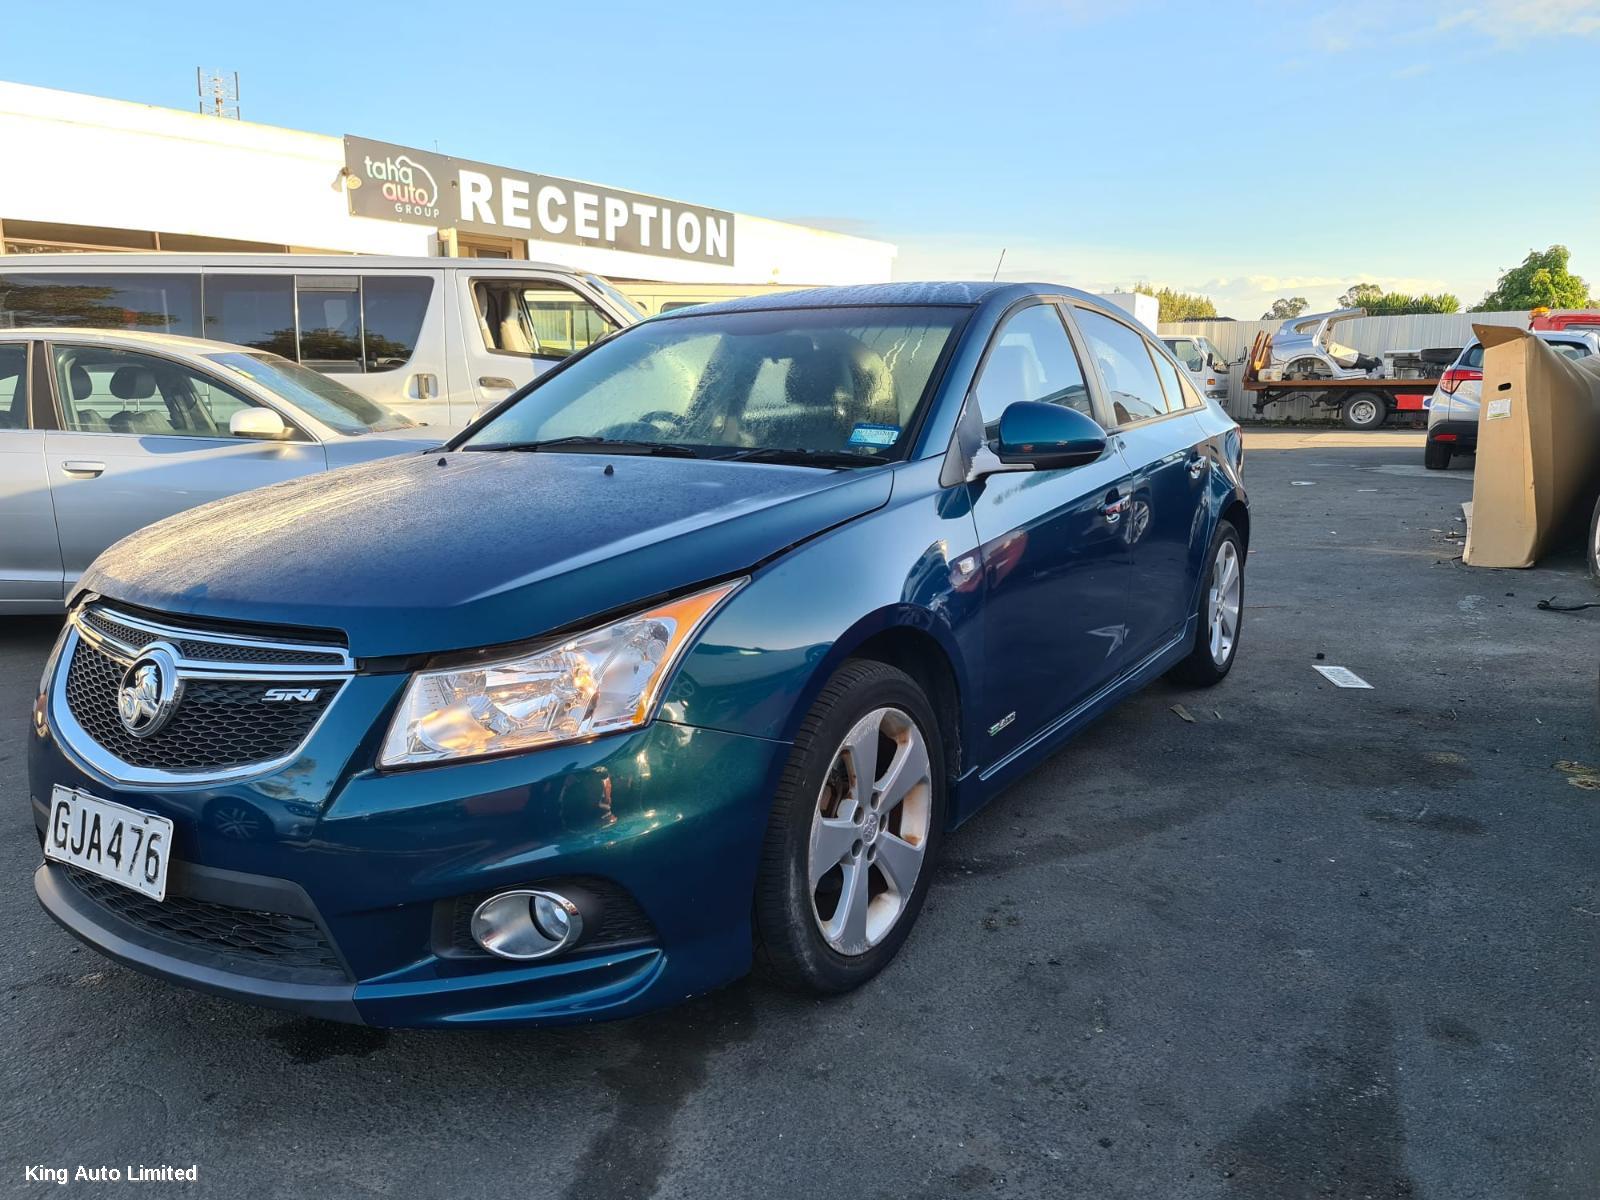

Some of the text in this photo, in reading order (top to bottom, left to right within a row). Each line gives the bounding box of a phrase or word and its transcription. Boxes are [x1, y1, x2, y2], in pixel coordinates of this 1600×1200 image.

[364, 155, 413, 185] taha
[382, 182, 429, 206] auto
[395, 203, 440, 218] GROUP
[458, 169, 729, 258] RECEPTION
[54, 800, 162, 885] GJA476
